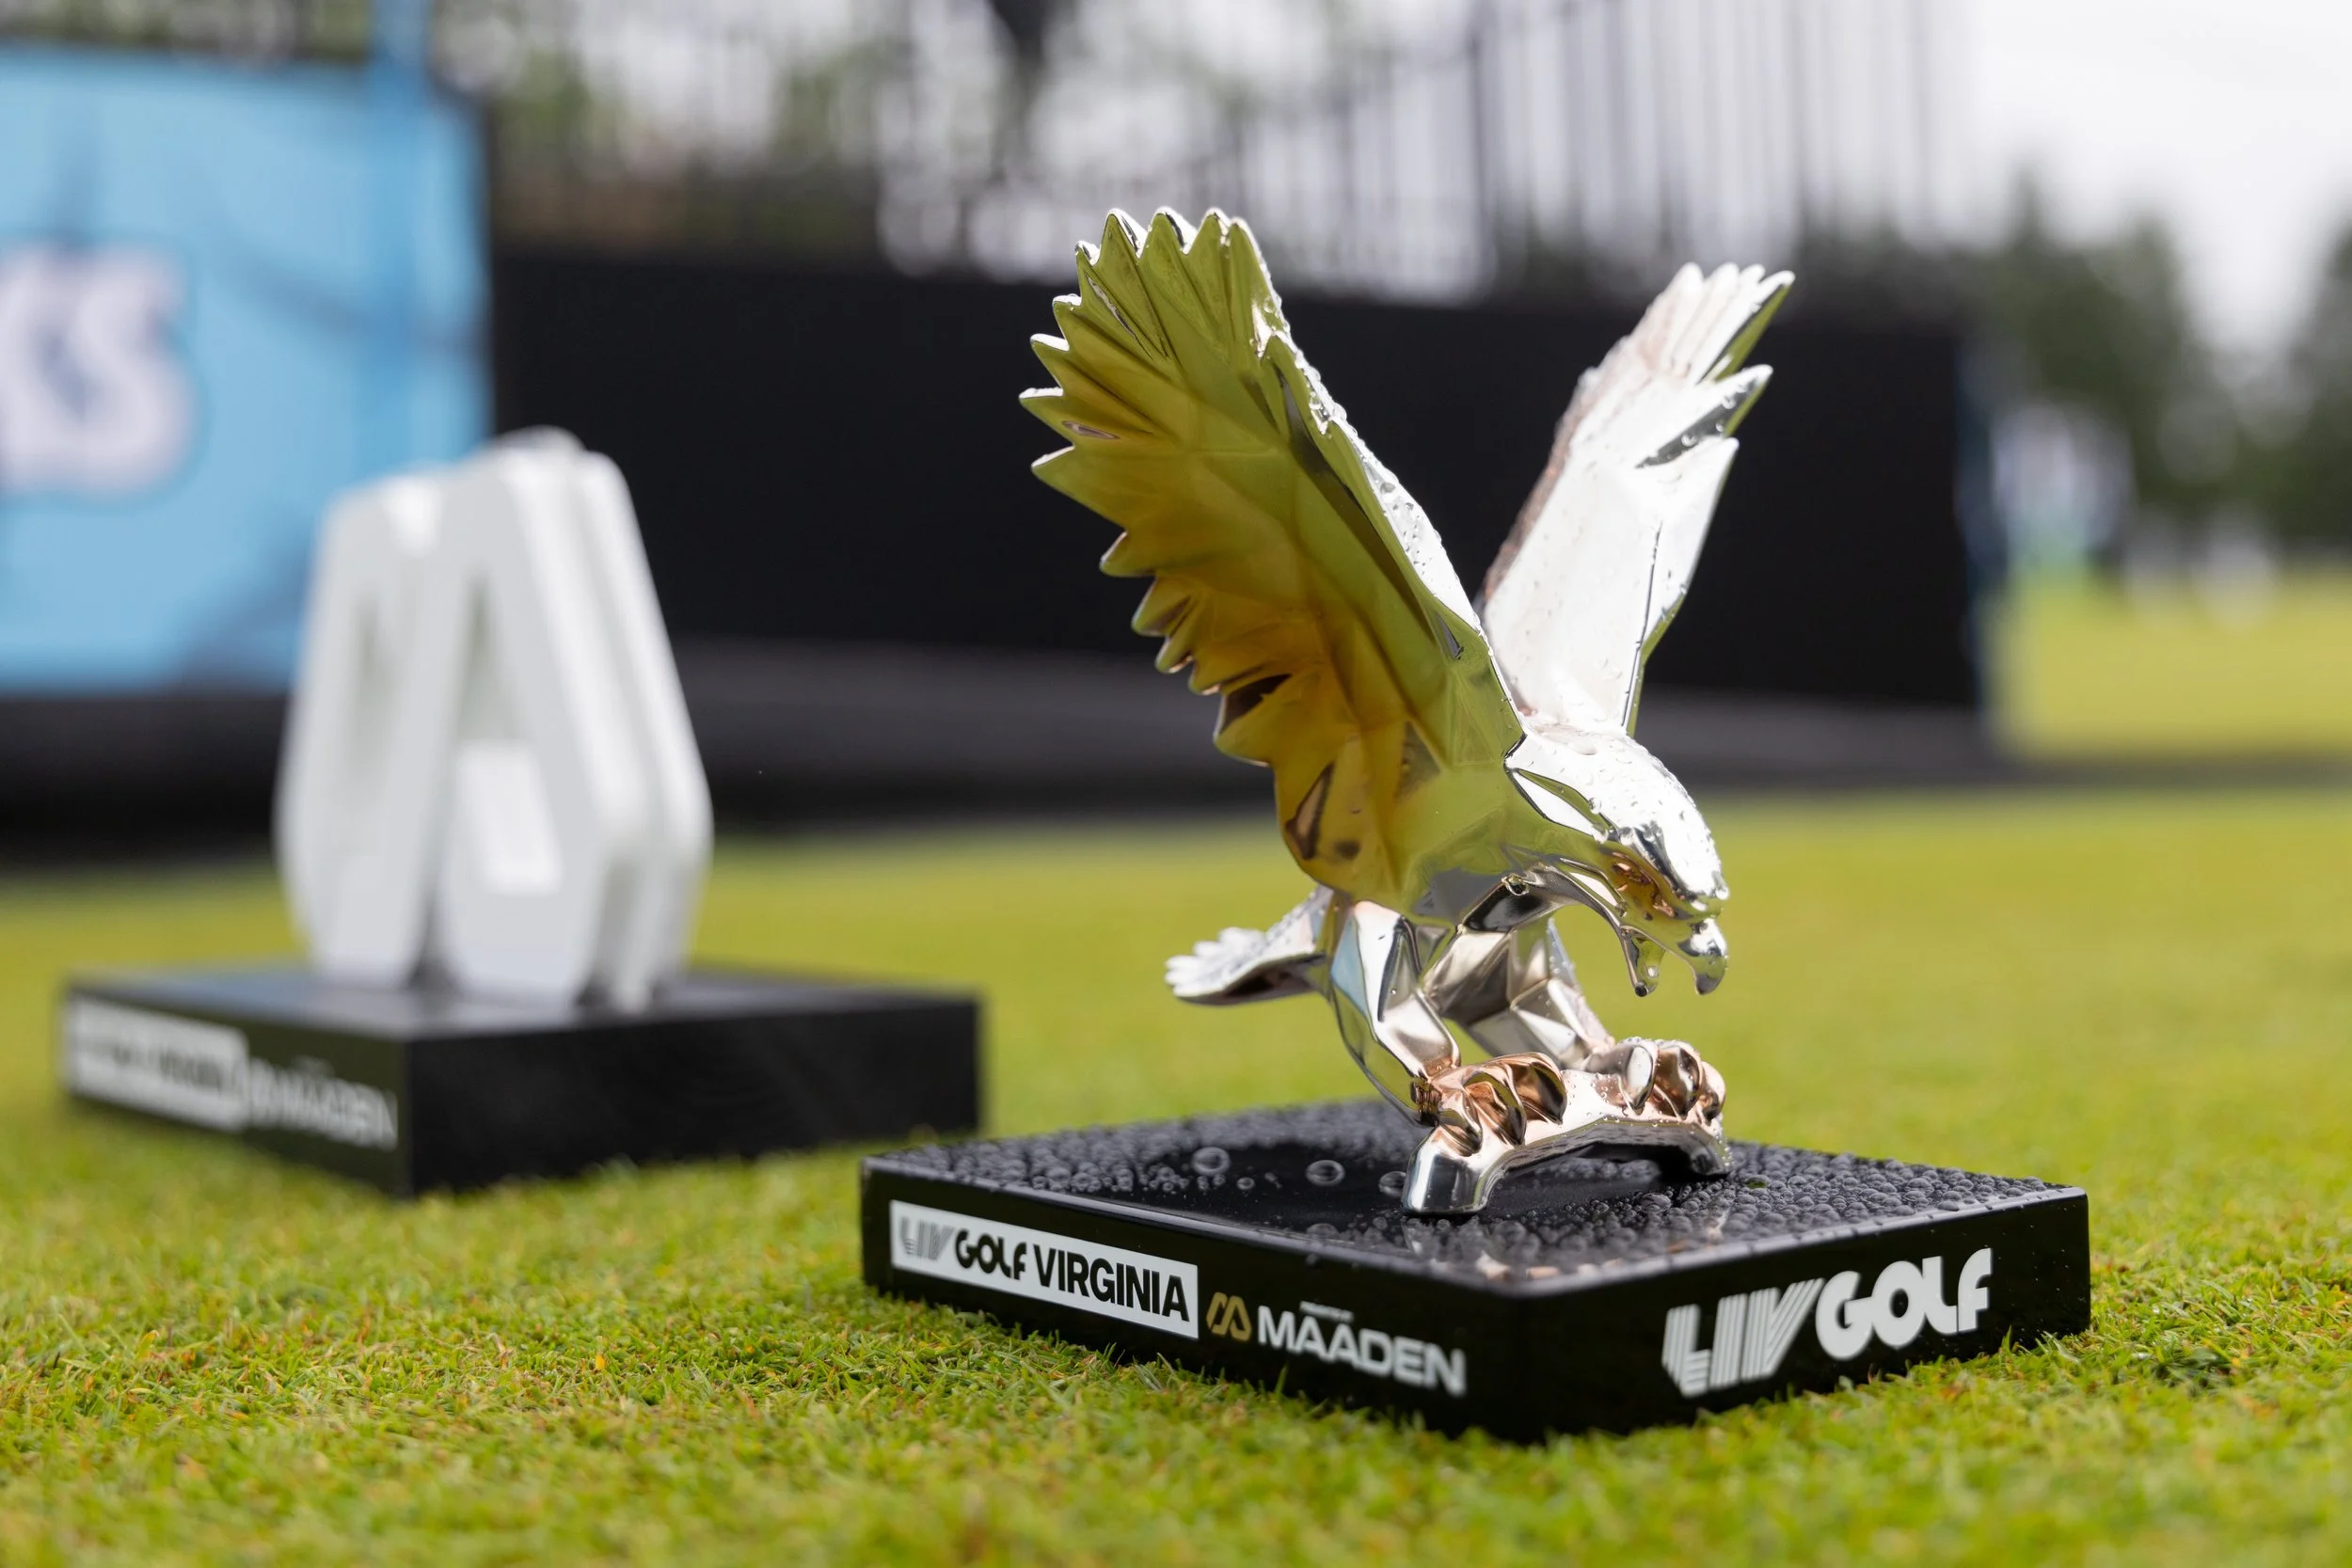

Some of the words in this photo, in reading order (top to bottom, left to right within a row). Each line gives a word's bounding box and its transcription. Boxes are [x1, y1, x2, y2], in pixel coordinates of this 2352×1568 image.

[899, 1215, 954, 1261] LIV
[955, 1227, 1027, 1281] GOLF
[1033, 1243, 1190, 1323] VIRGINIA
[1661, 1276, 1825, 1398] LIV
[1815, 1247, 1993, 1361] GOLF
[1257, 1305, 1466, 1397] MAADEN
